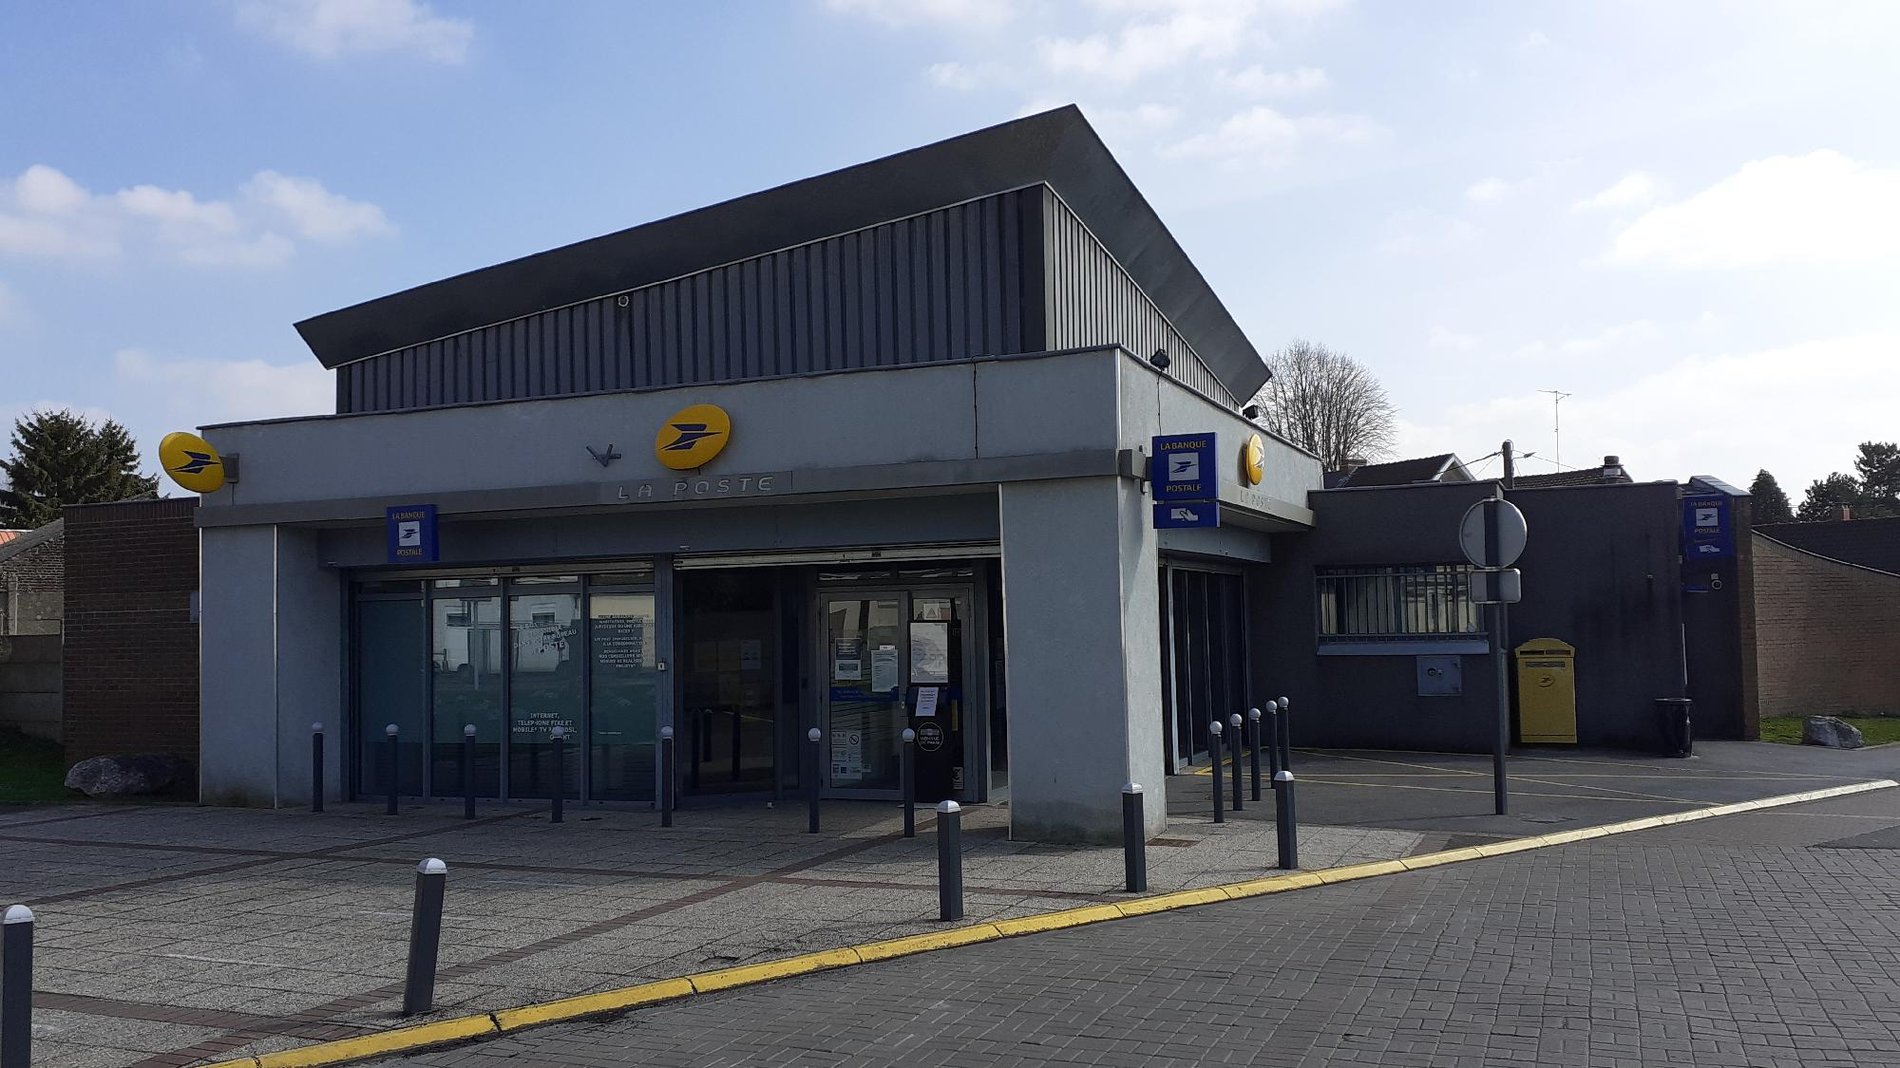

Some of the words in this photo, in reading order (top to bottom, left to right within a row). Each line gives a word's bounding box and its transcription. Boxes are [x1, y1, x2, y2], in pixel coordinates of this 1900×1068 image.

[1160, 442, 1171, 451] LA
[1171, 440, 1207, 450] BANQUE
[618, 483, 653, 500] LA
[673, 476, 773, 496] POSTE
[1166, 483, 1201, 492] POSTALE
[391, 512, 400, 520] LA
[400, 511, 425, 519] BANQUE
[396, 548, 423, 556] POSTALE
